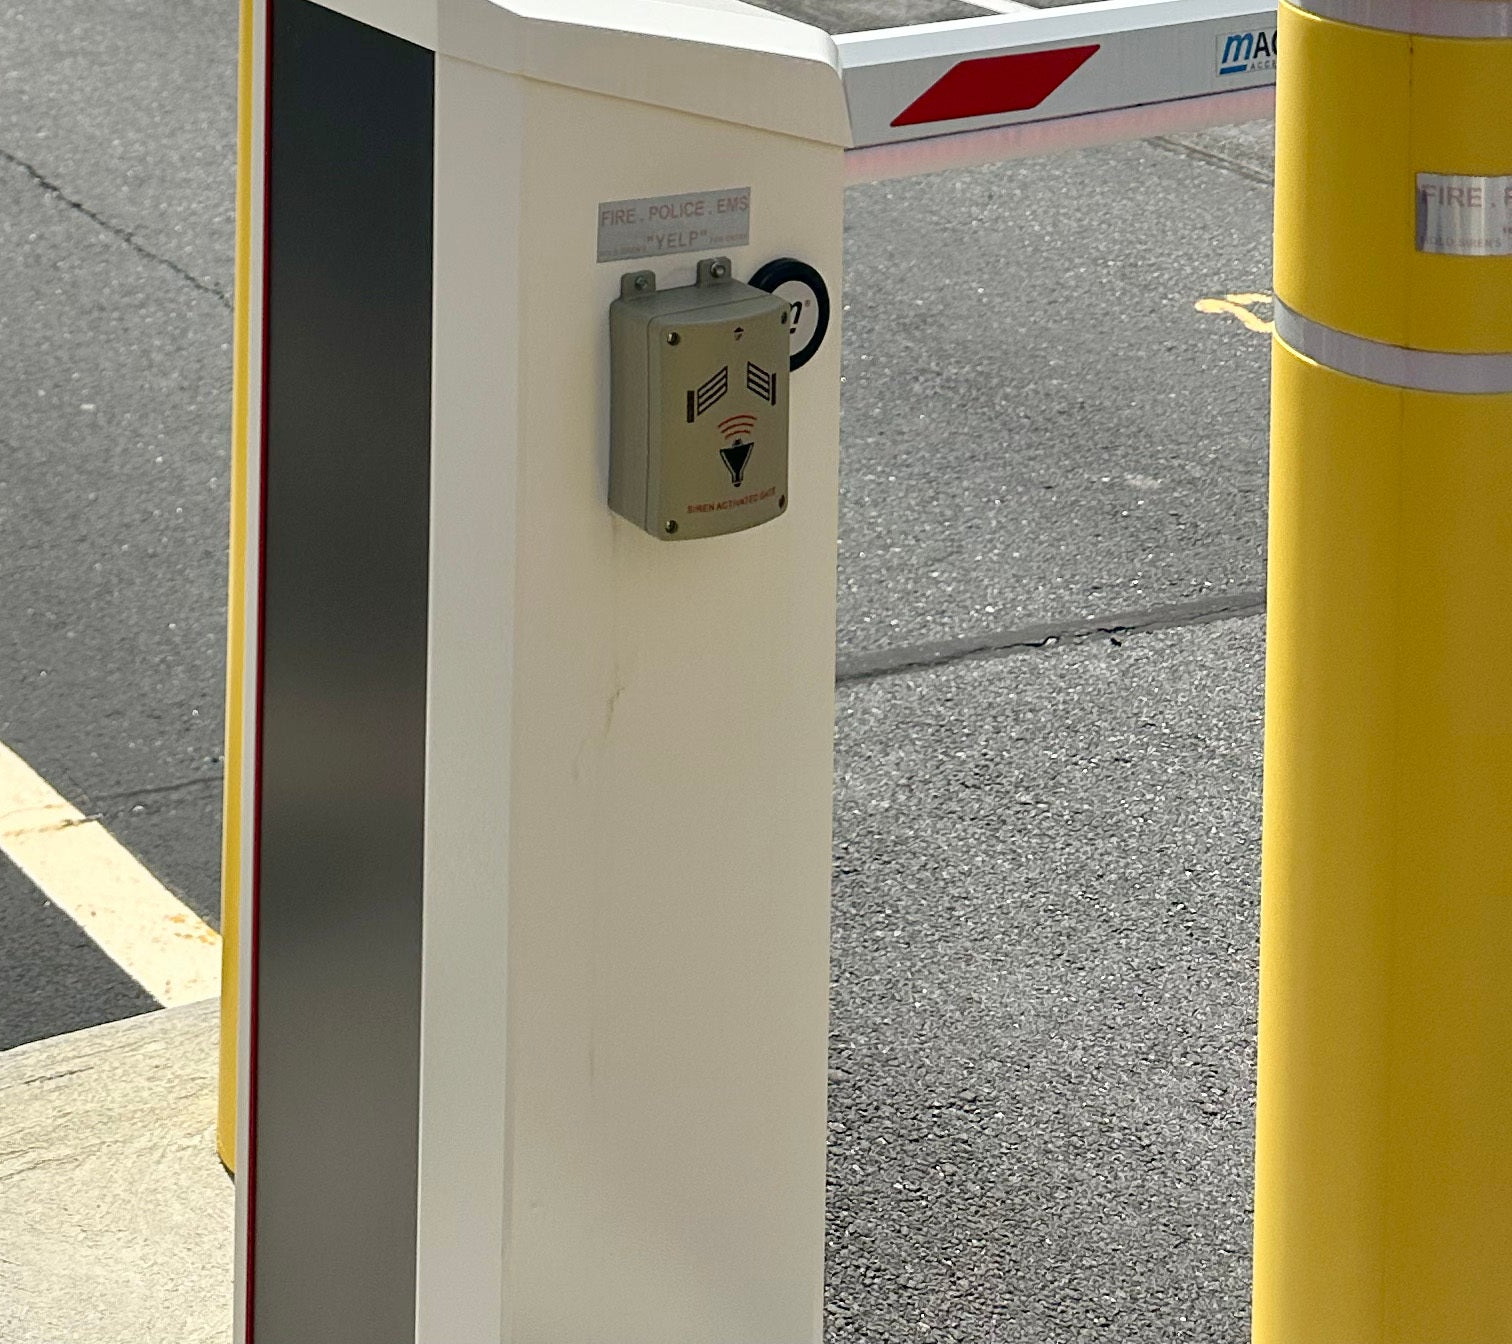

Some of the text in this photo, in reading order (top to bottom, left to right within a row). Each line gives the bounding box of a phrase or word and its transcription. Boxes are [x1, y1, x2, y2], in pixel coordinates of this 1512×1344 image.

[1420, 183, 1482, 208] FIRE
[601, 195, 749, 226] FIRE POLICE EMS
[647, 228, 708, 250] "YELP"
